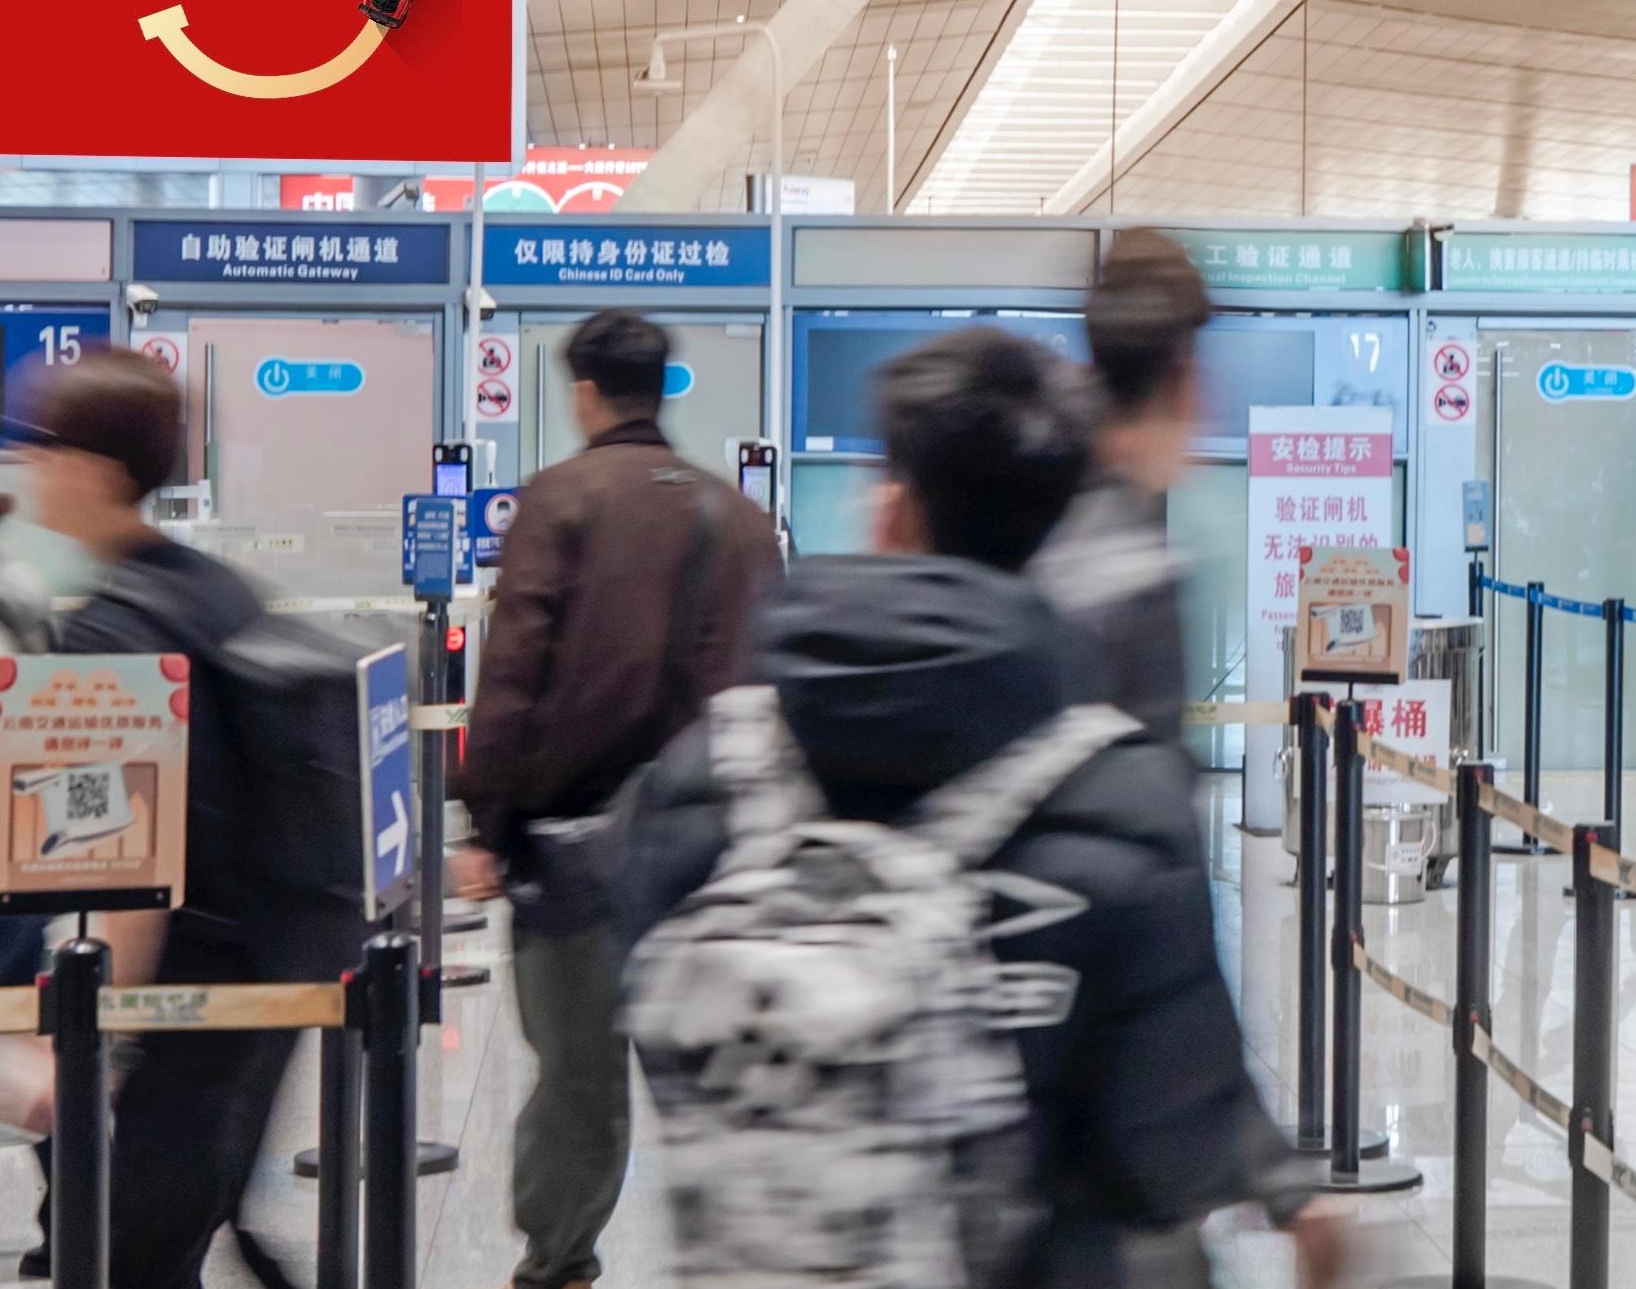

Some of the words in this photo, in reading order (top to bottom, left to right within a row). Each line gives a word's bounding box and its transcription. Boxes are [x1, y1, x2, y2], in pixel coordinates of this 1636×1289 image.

[181, 234, 399, 264] 自助验证闸机通道
[515, 238, 730, 267] 仅限持身份证过检
[1184, 244, 1352, 269] 工验证通道
[222, 263, 295, 279] Automatic
[297, 264, 360, 281] Gateway
[558, 267, 607, 282] Chinese
[609, 268, 623, 282] ID
[624, 268, 655, 282] Card
[656, 268, 686, 284] Only
[1228, 272, 1293, 287] Inspection
[1295, 273, 1347, 285] Channel
[38, 325, 81, 366] 15
[1350, 333, 1381, 373] 17
[1271, 436, 1373, 462] 安检提示
[1286, 463, 1332, 475] Security
[1334, 463, 1357, 475] Tips
[1276, 496, 1368, 522] 验证闸机
